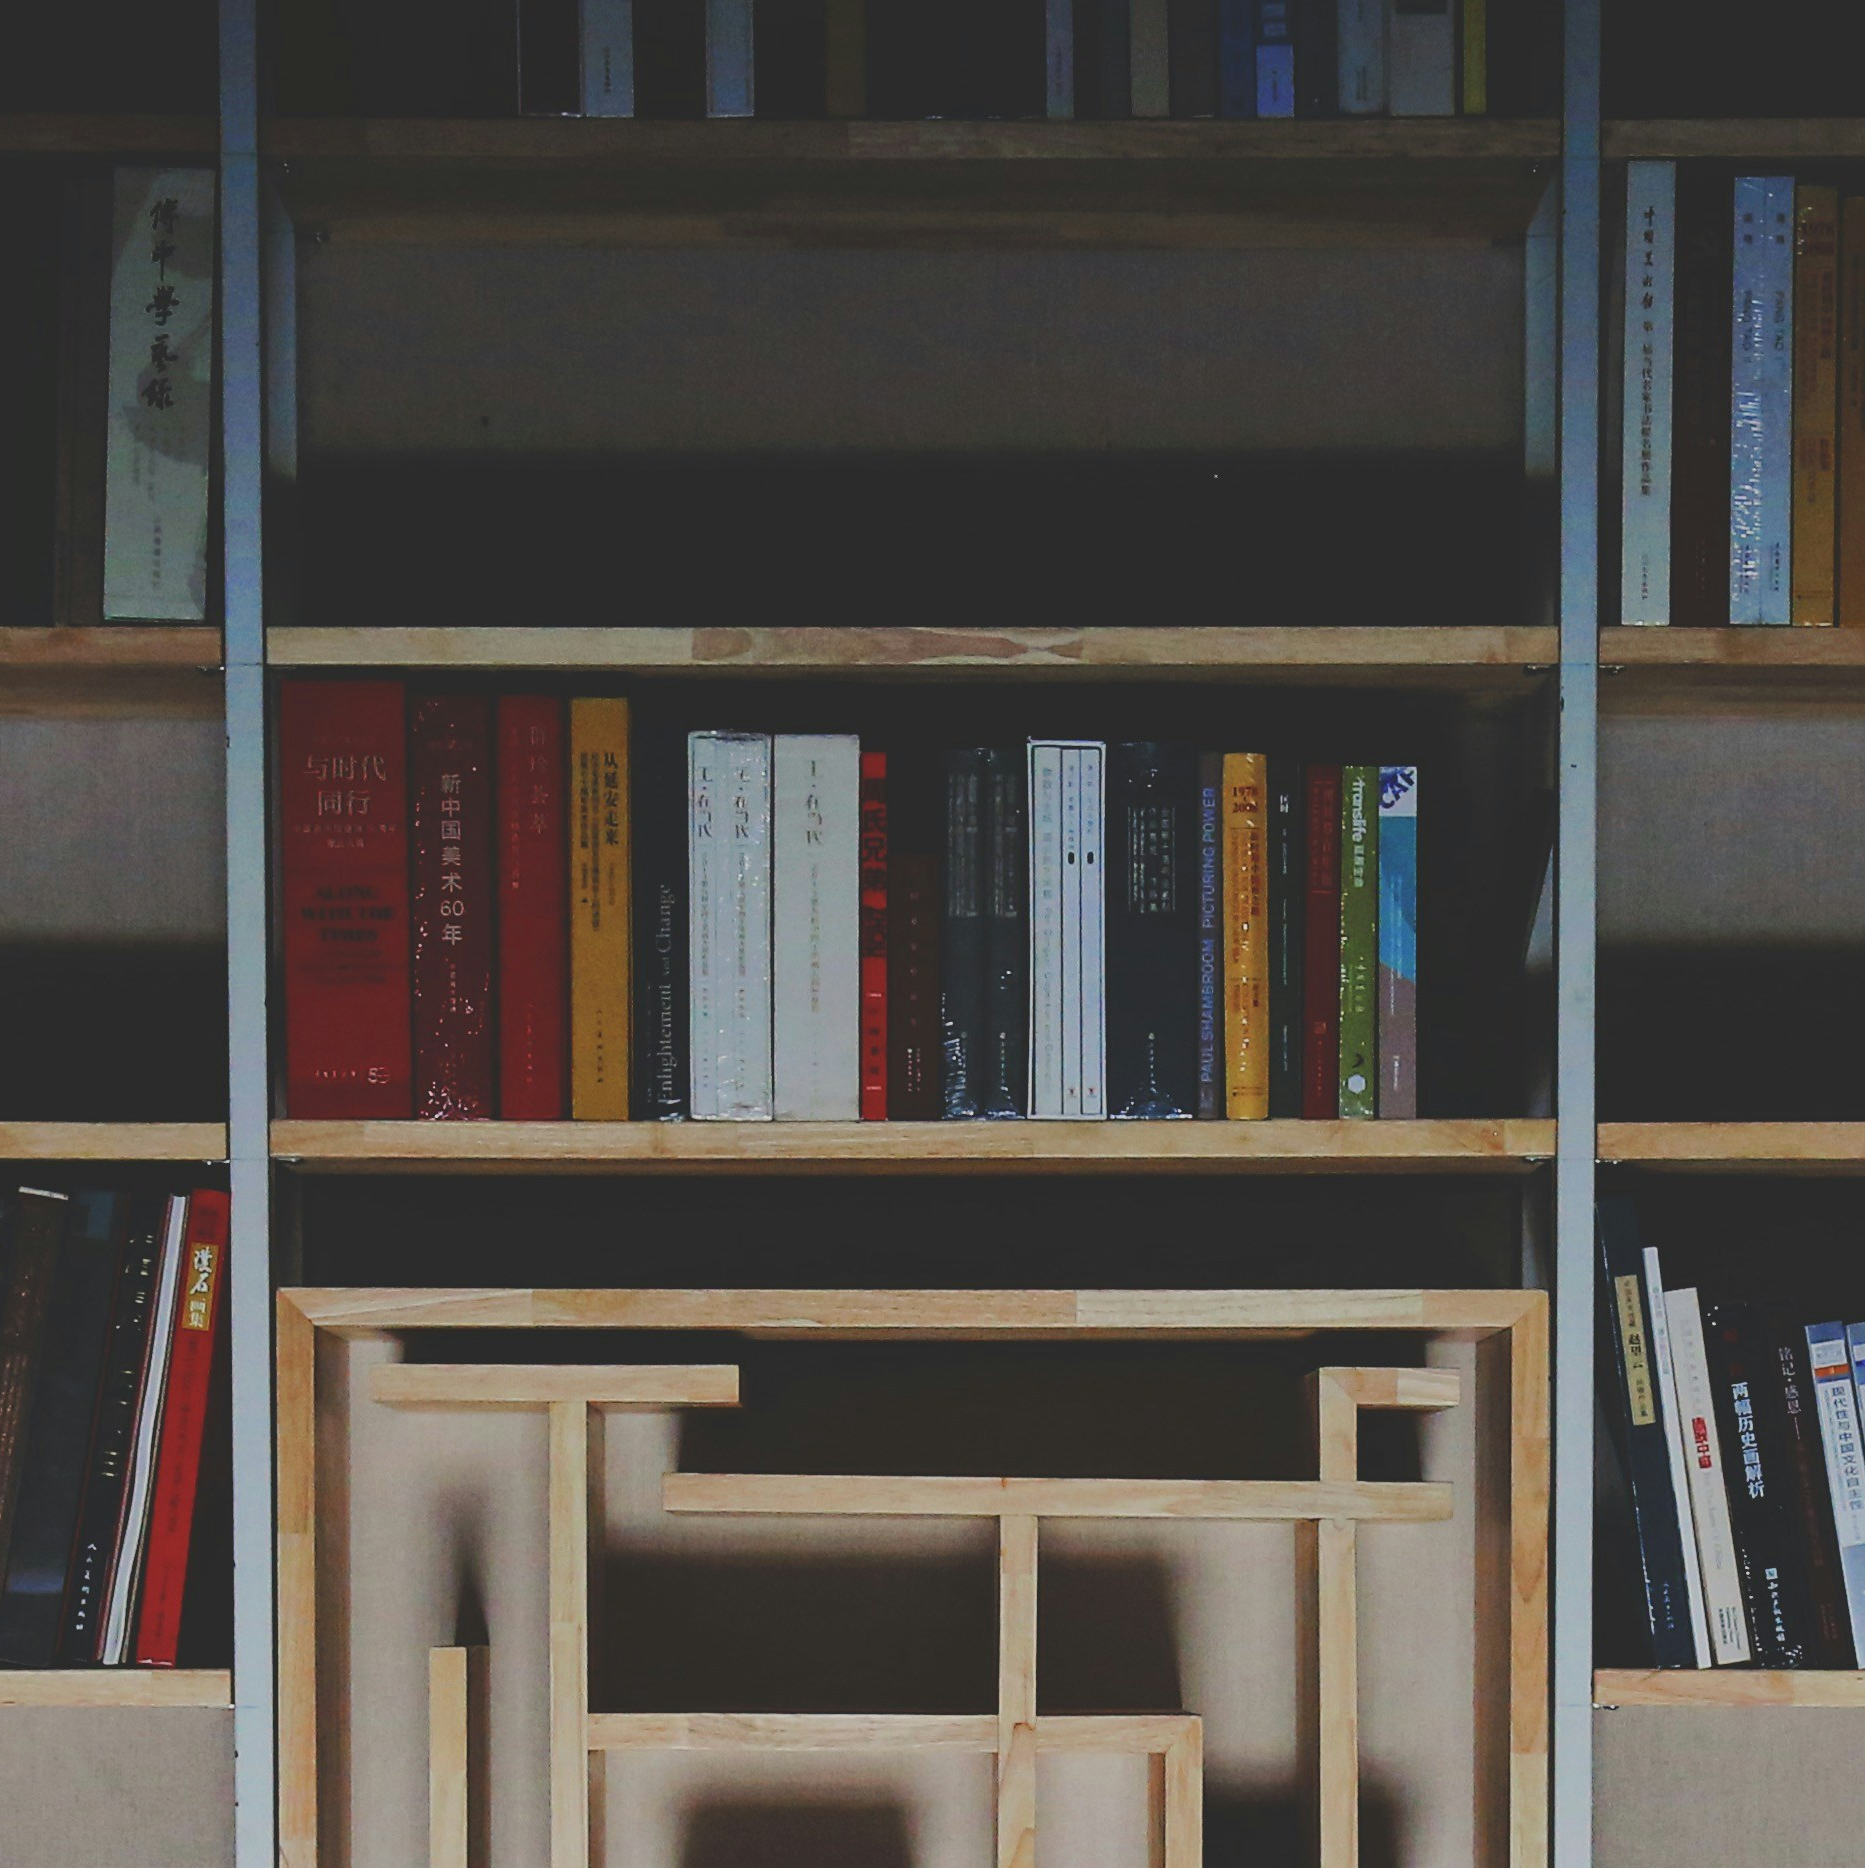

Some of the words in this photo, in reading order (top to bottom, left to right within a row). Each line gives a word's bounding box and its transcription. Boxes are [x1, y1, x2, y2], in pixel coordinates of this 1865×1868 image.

[1202, 788, 1216, 842] POWER
[439, 772, 465, 947] 新中国美术60年
[1202, 848, 1215, 928] PICTURING
[1201, 939, 1215, 1041] SHAMBROOM
[1200, 1046, 1214, 1083] PAUL
